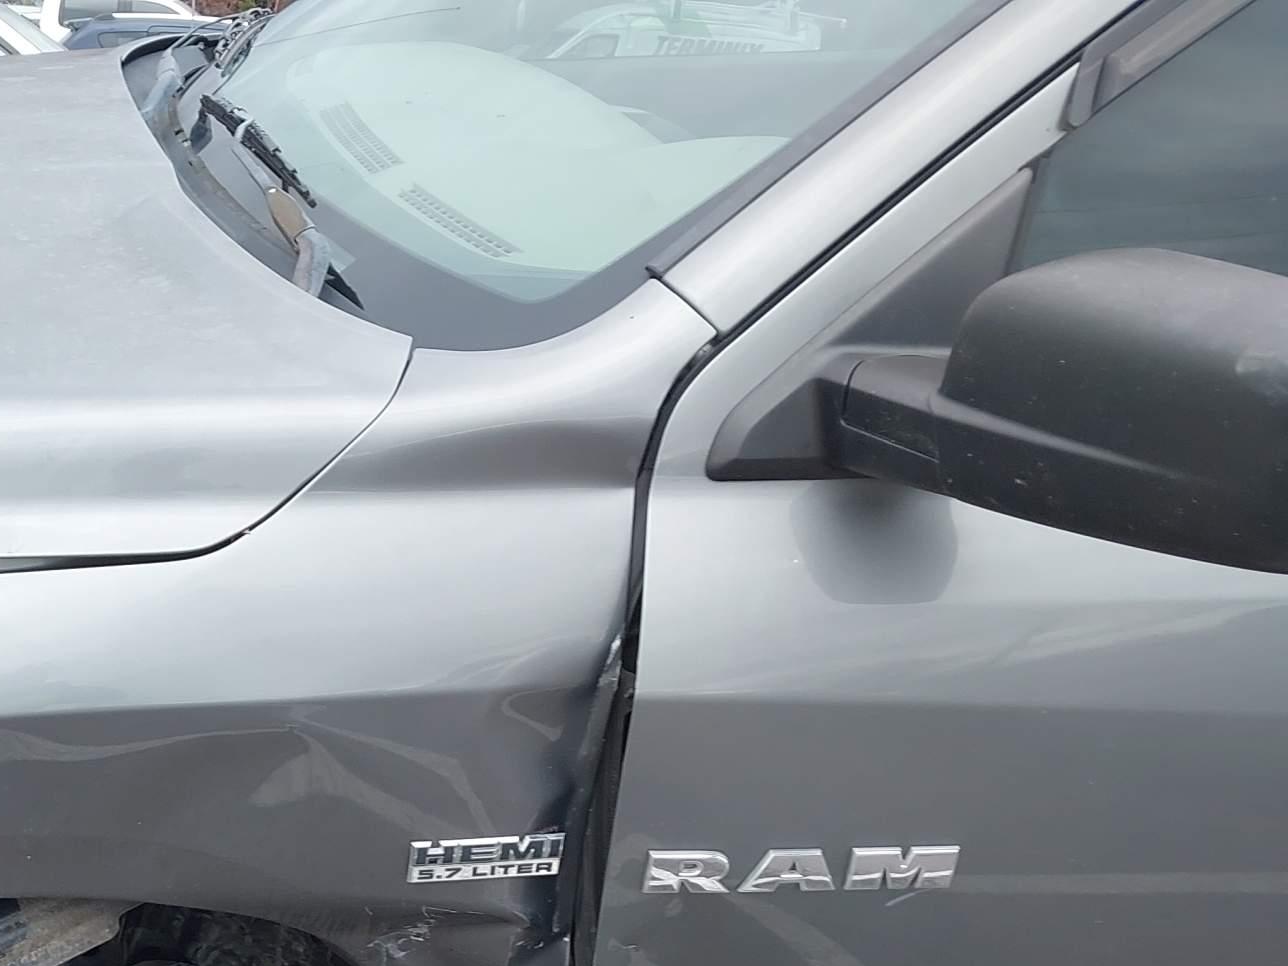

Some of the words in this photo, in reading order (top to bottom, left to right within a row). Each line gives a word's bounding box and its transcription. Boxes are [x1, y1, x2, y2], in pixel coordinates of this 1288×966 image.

[409, 832, 566, 867] HEMI
[417, 867, 462, 880] 5.7
[472, 862, 554, 878] LITER
[646, 846, 961, 892] RAM
